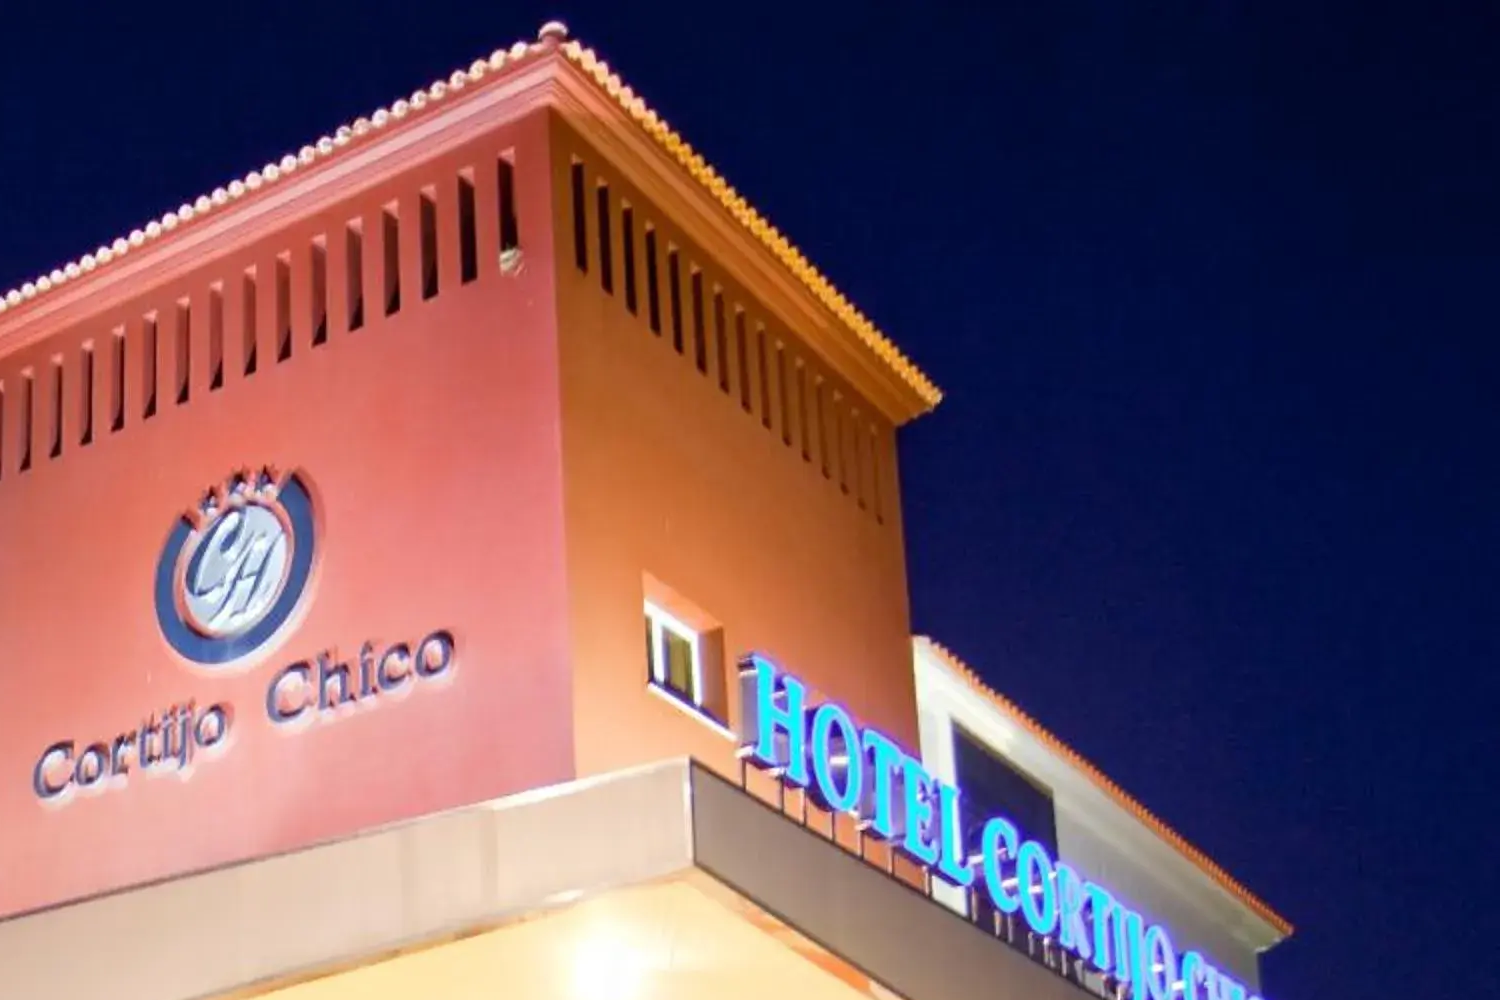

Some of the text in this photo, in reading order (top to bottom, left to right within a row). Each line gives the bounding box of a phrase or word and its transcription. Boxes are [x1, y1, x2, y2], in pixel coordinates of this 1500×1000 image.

[33, 628, 456, 799] Cortijo Chico
[748, 653, 974, 886] HOTEL
